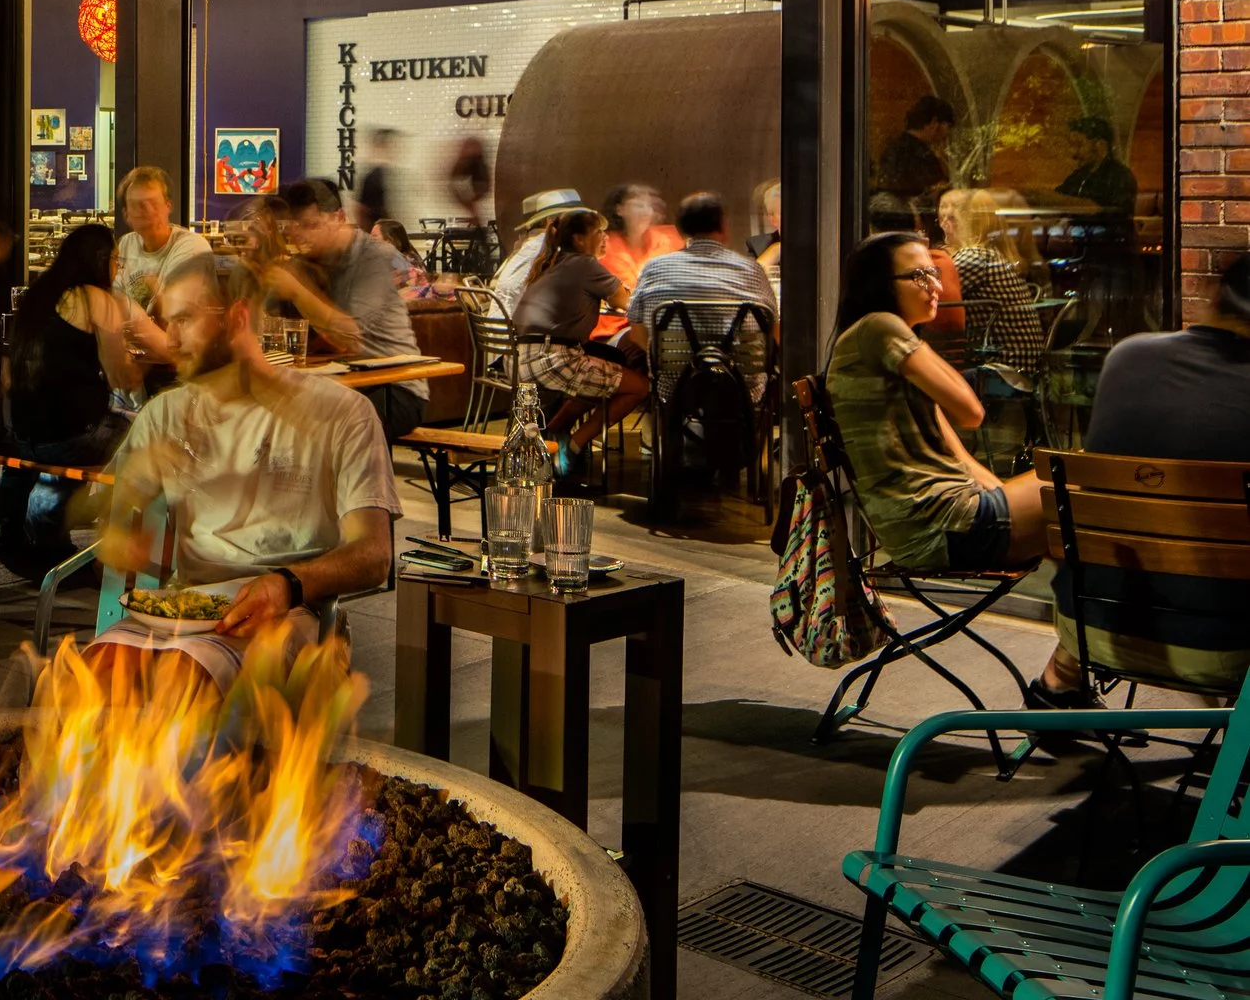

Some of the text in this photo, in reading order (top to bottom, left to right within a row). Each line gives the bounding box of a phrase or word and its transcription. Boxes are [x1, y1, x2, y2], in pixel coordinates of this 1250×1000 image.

[370, 55, 488, 82] KEUKEN
[338, 43, 357, 190] KITCHEN
[456, 94, 513, 118] CUI
